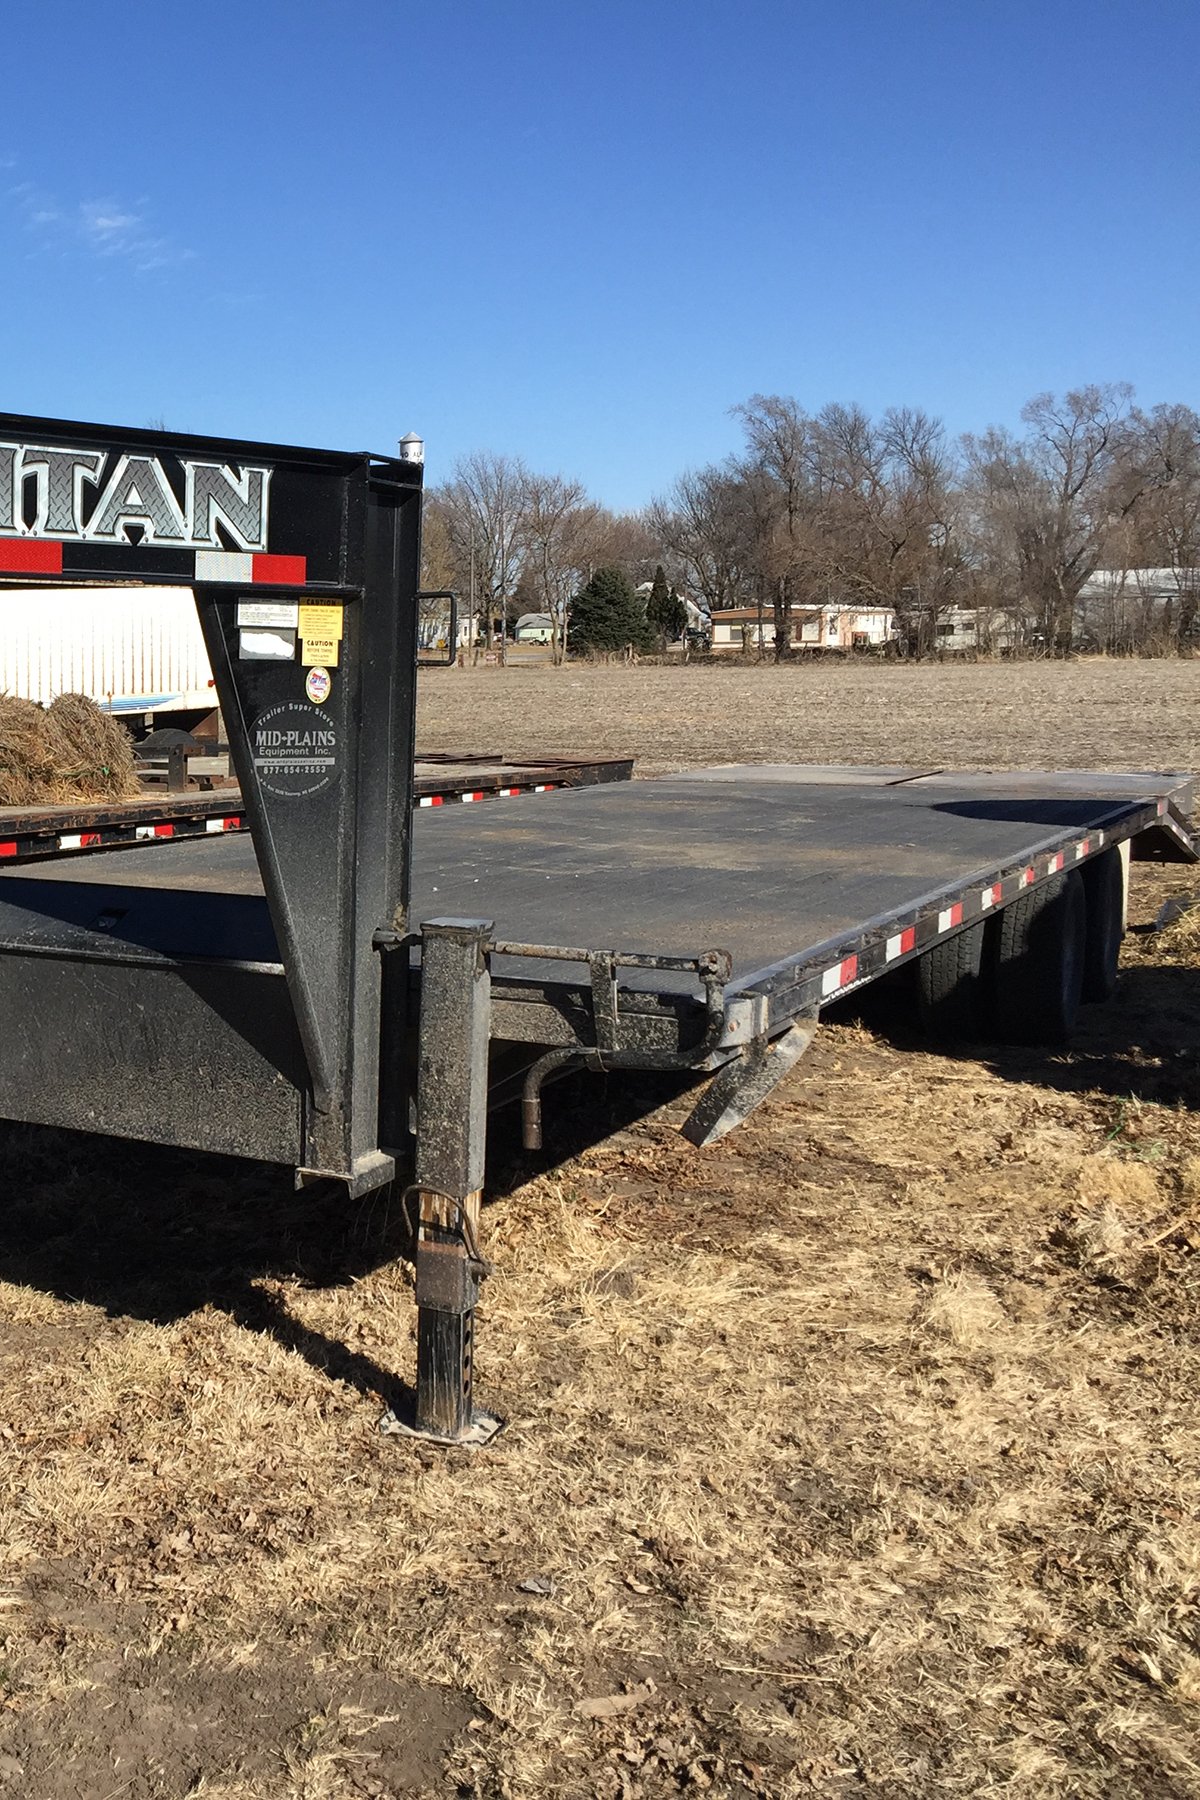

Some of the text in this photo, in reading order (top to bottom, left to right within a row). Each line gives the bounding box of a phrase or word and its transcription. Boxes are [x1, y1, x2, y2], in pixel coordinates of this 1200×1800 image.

[306, 639, 334, 647] CAUTION
[257, 703, 334, 727] Trailer Super Store
[255, 730, 336, 746] MID-PLAINS
[259, 746, 331, 757] Equipment Inc.
